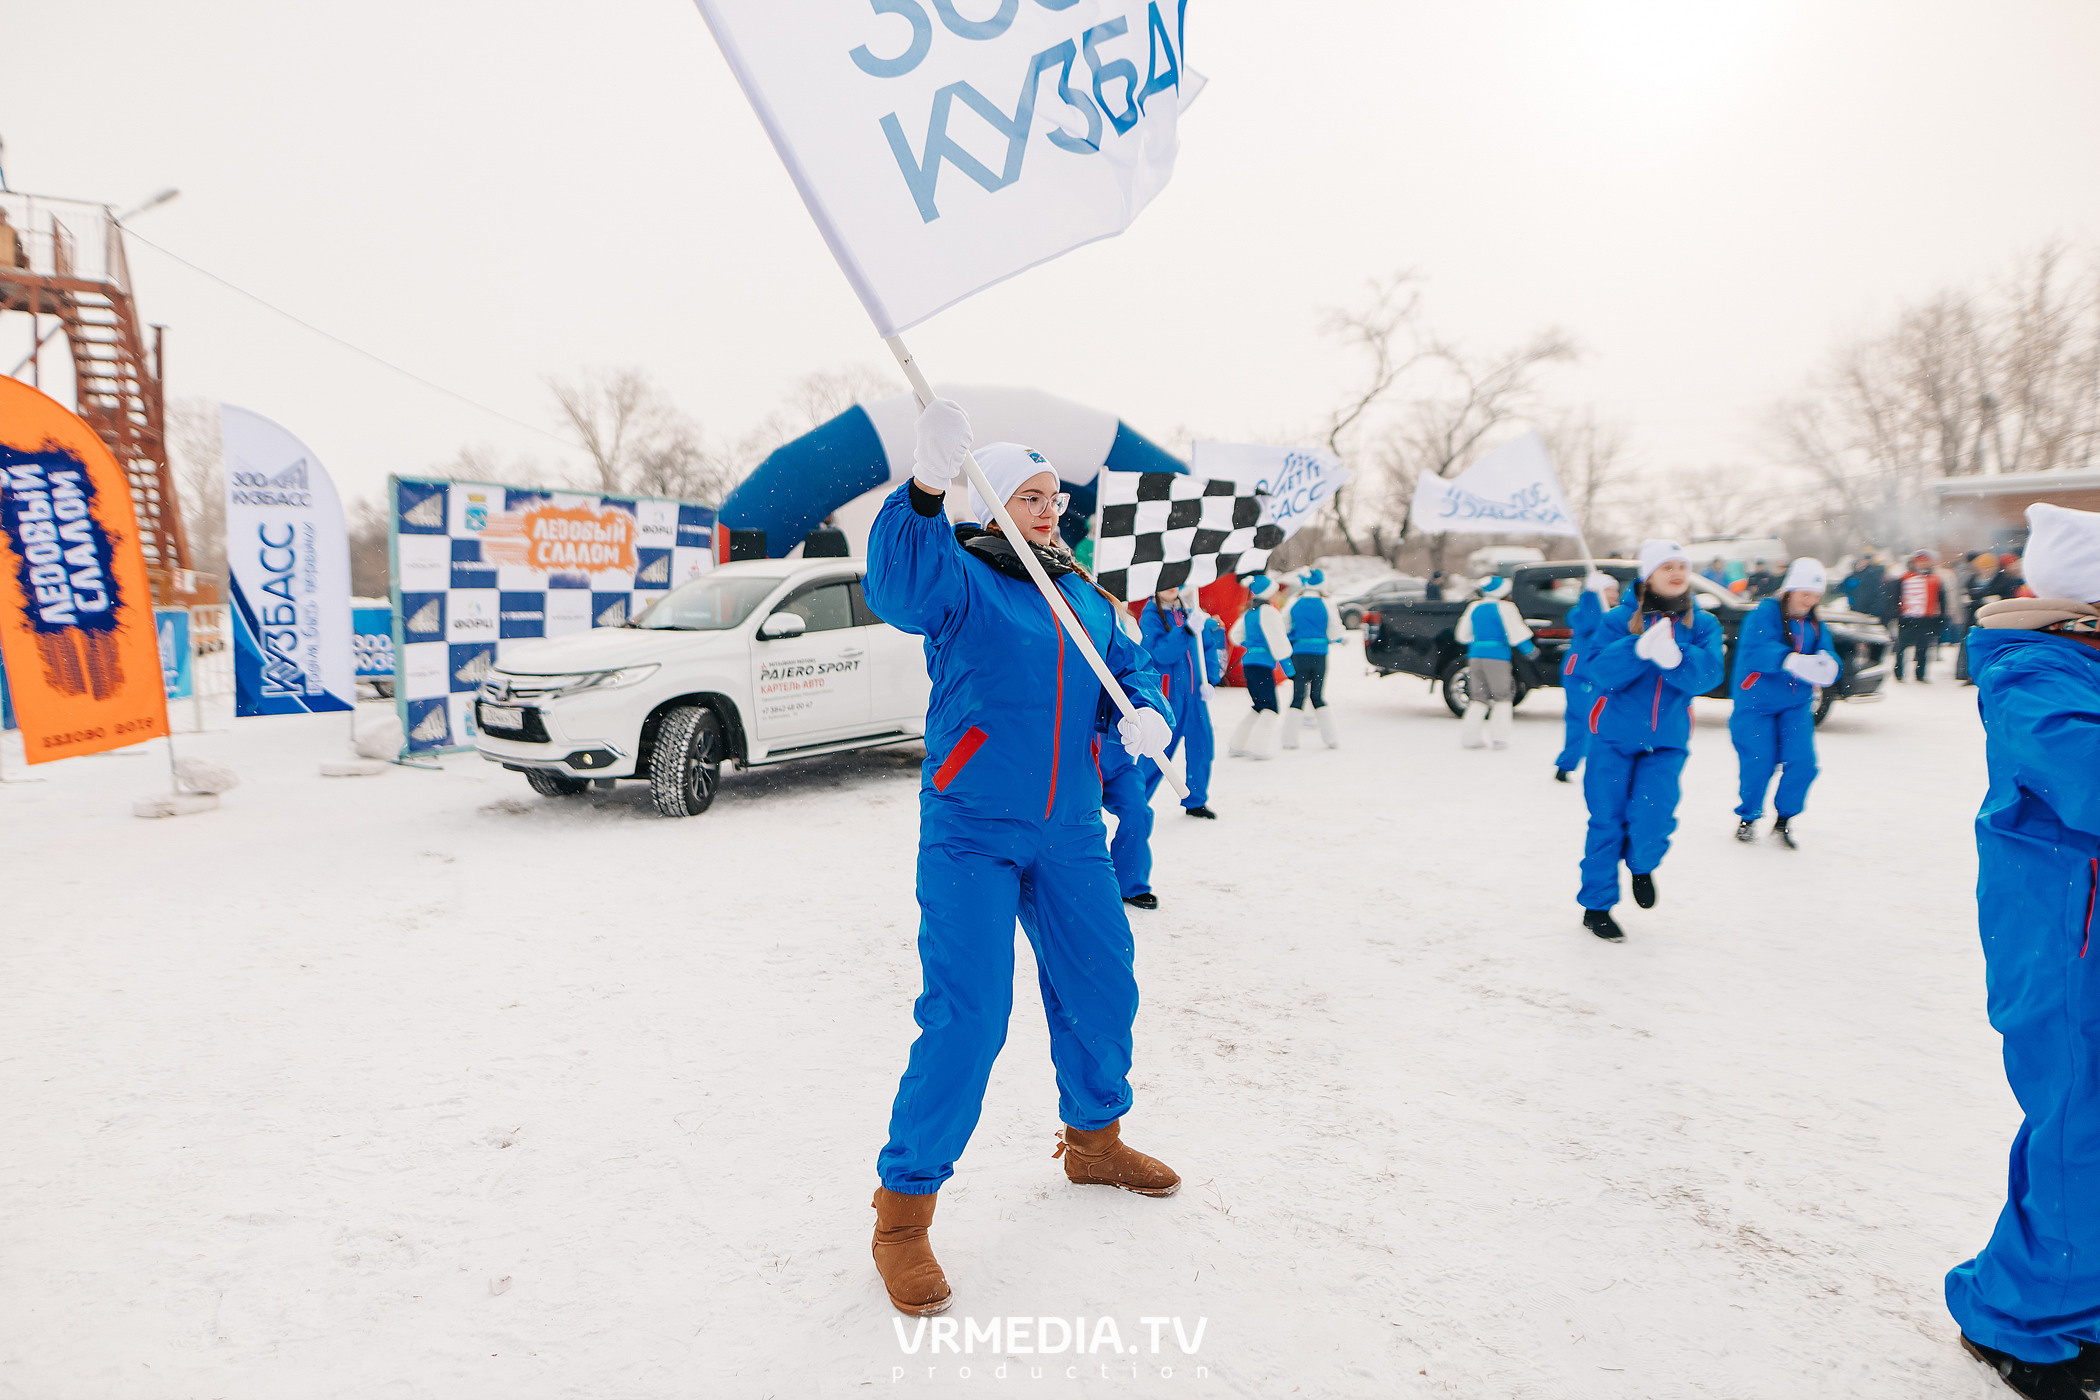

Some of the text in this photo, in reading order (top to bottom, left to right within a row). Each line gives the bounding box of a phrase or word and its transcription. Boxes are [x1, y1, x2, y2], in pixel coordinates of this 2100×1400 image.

[48, 470, 110, 613] СЛАЛОМ
[533, 517, 626, 543] ЛЕДОВЫЙ
[0, 463, 79, 625] ЛЕДОВЫЙ
[537, 540, 619, 564] СЛАЛОМ
[260, 522, 305, 698] КУЗБАСС
[760, 660, 861, 681] PAJERO SPORT
[760, 678, 825, 694] КАРТЕЛЬ АВТО
